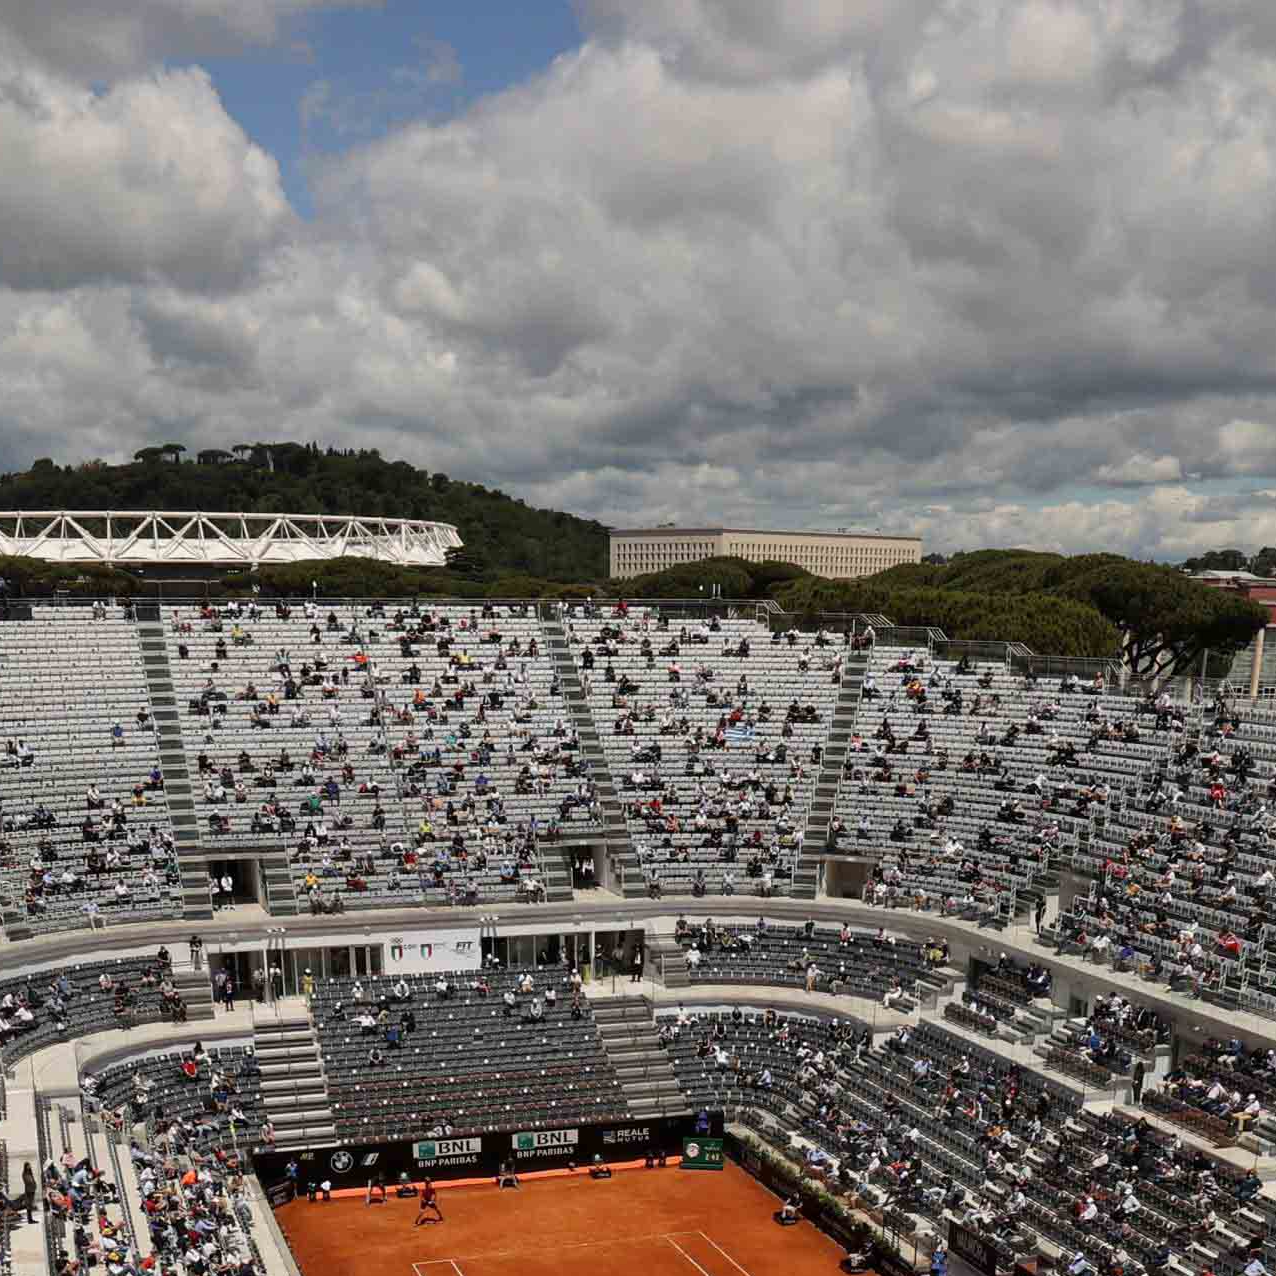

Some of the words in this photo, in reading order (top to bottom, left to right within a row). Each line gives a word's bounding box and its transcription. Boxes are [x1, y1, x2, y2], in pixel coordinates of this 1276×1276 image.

[537, 1129, 575, 1145] BNL
[617, 1127, 650, 1137] REALE
[438, 1141, 476, 1154] BNL
[516, 1150, 536, 1159] BNP
[537, 1146, 573, 1157] PARIBAS
[418, 1159, 437, 1168] BNP
[438, 1155, 477, 1167] PARIBAS
